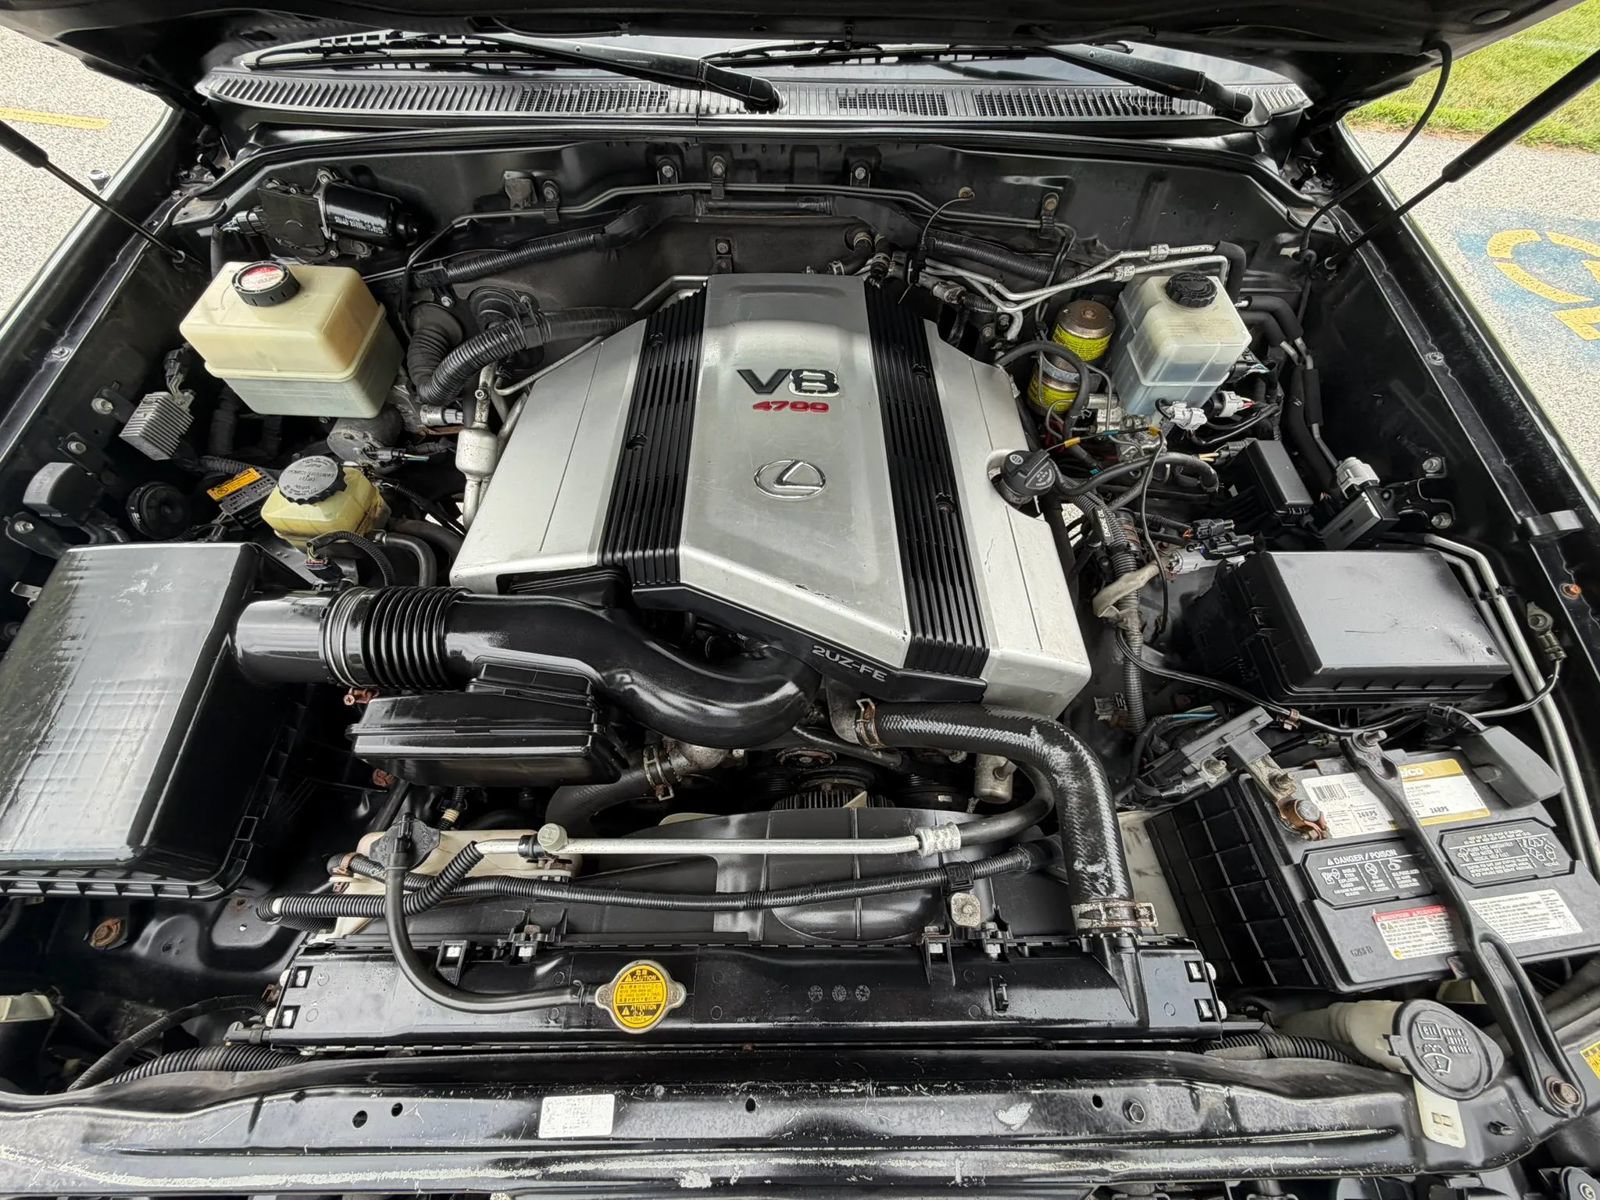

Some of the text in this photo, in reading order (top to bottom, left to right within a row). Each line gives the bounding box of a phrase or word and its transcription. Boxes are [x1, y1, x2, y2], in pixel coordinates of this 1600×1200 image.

[736, 368, 840, 397] V8
[752, 400, 830, 413] 4700
[811, 644, 888, 682] 2UZ-FE
[1332, 854, 1365, 865] DANGER
[1369, 849, 1398, 860] POISON
